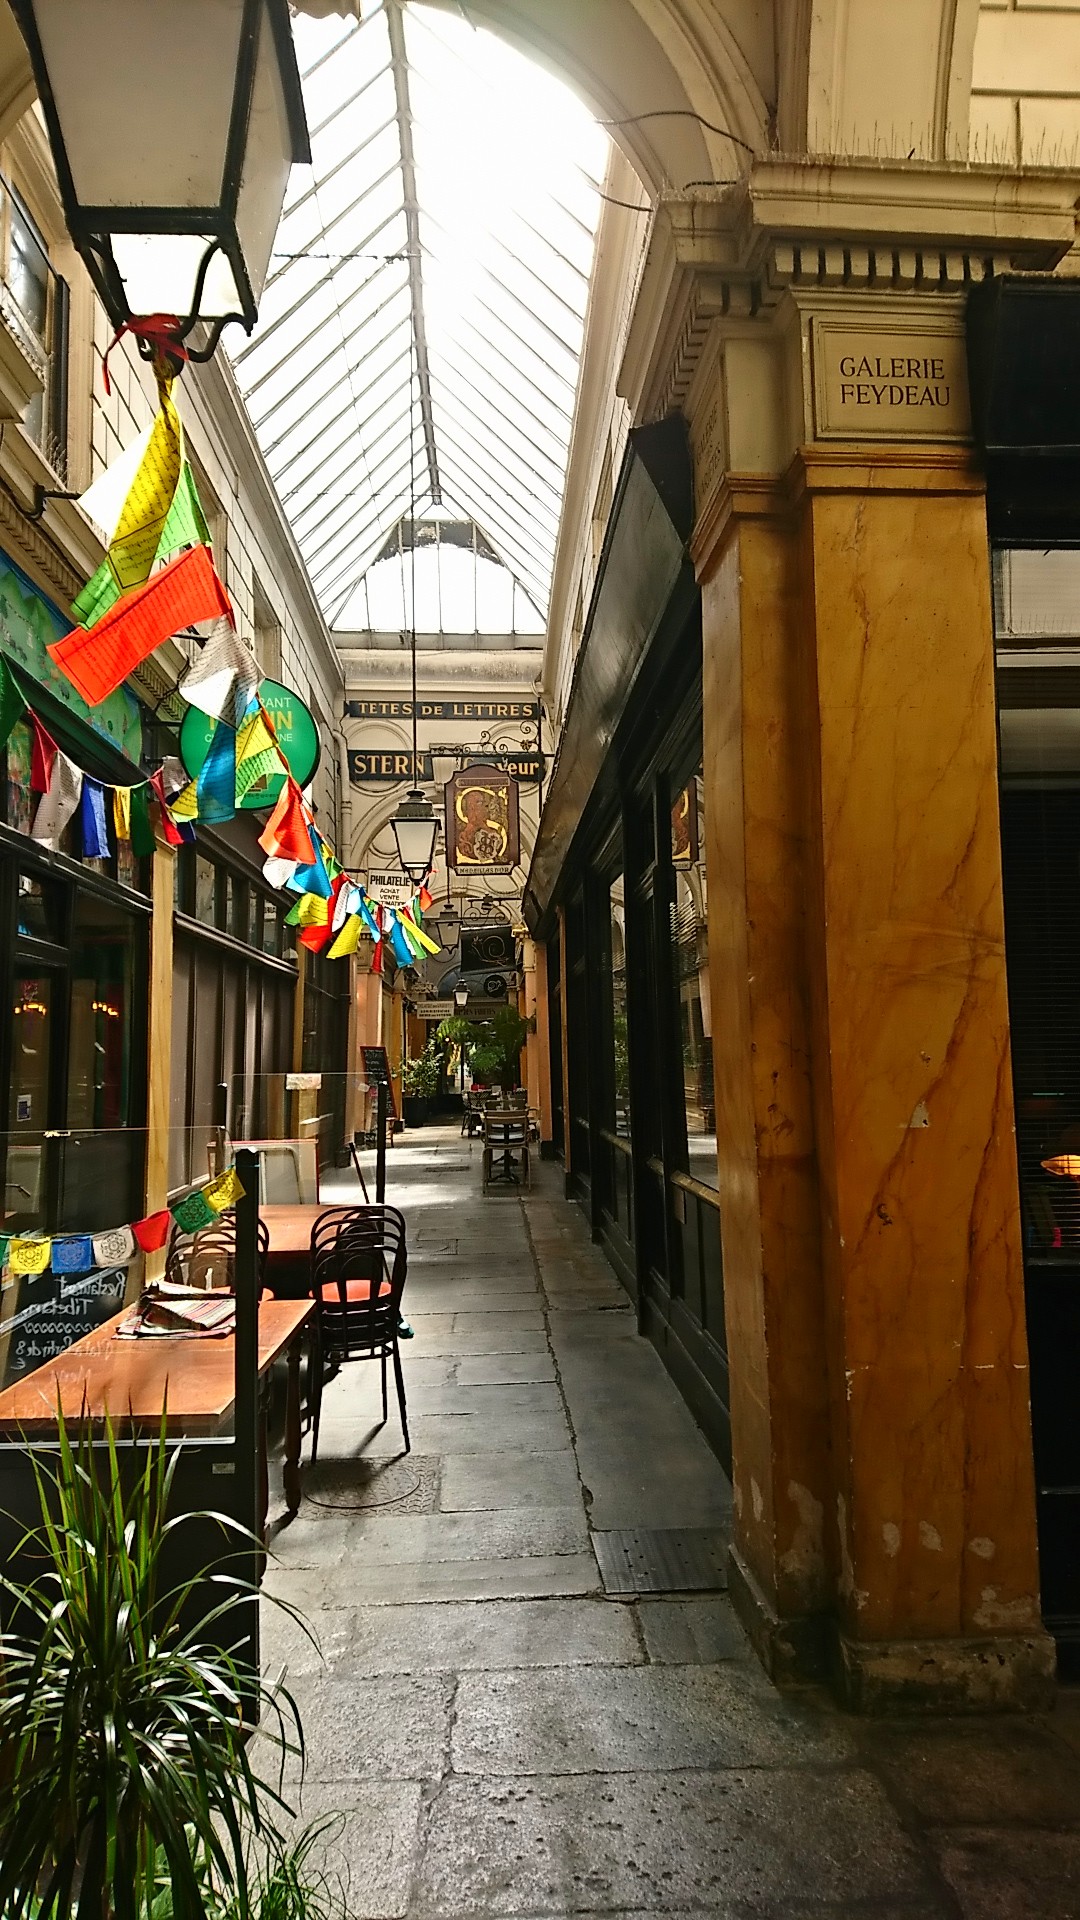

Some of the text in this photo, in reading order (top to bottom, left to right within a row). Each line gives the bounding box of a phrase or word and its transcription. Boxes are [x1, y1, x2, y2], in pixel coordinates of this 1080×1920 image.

[840, 356, 945, 379] GALERIE
[840, 384, 950, 407] FEYDEAU
[359, 702, 533, 717] TETES DE LETTRES
[354, 754, 425, 775] STERN
[463, 757, 540, 775] veur
[370, 875, 411, 887] PHILATELIE
